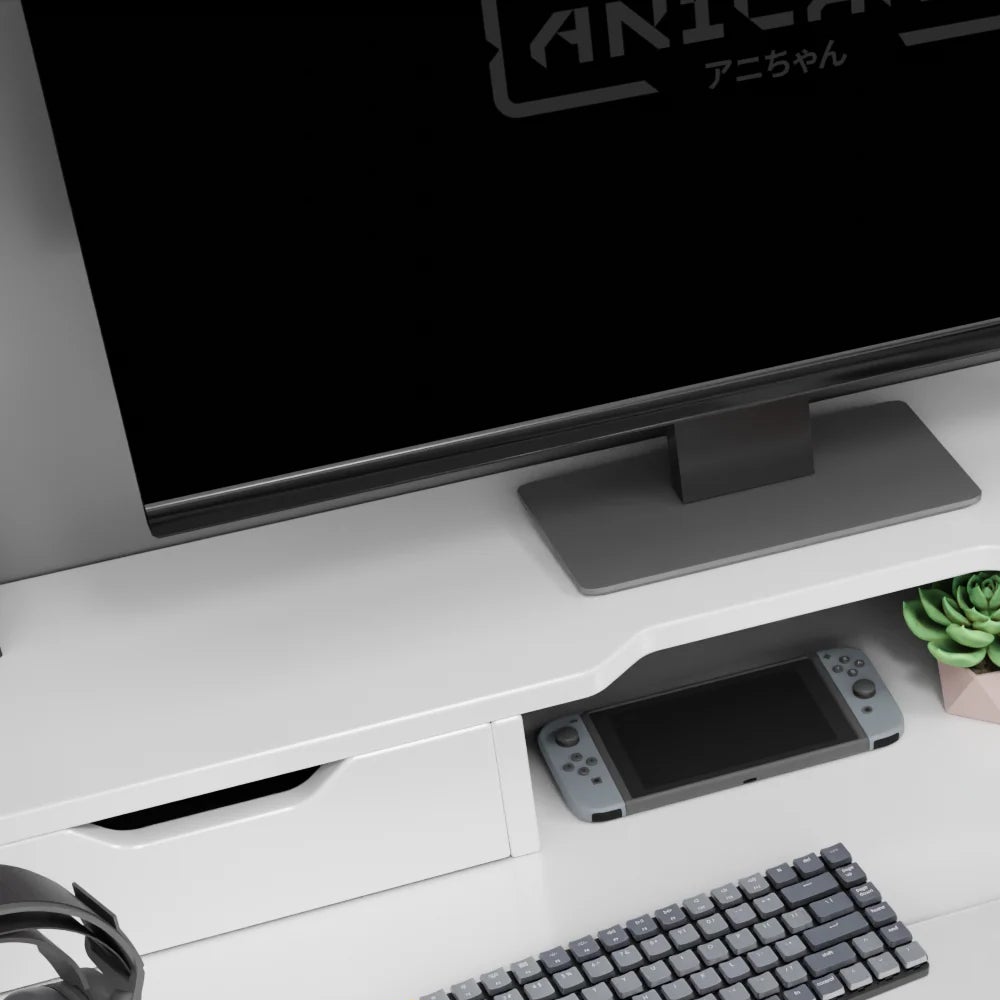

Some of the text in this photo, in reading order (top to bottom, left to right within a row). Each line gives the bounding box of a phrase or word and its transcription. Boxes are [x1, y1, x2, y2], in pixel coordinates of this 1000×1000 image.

[705, 40, 848, 90] アニちゃん
